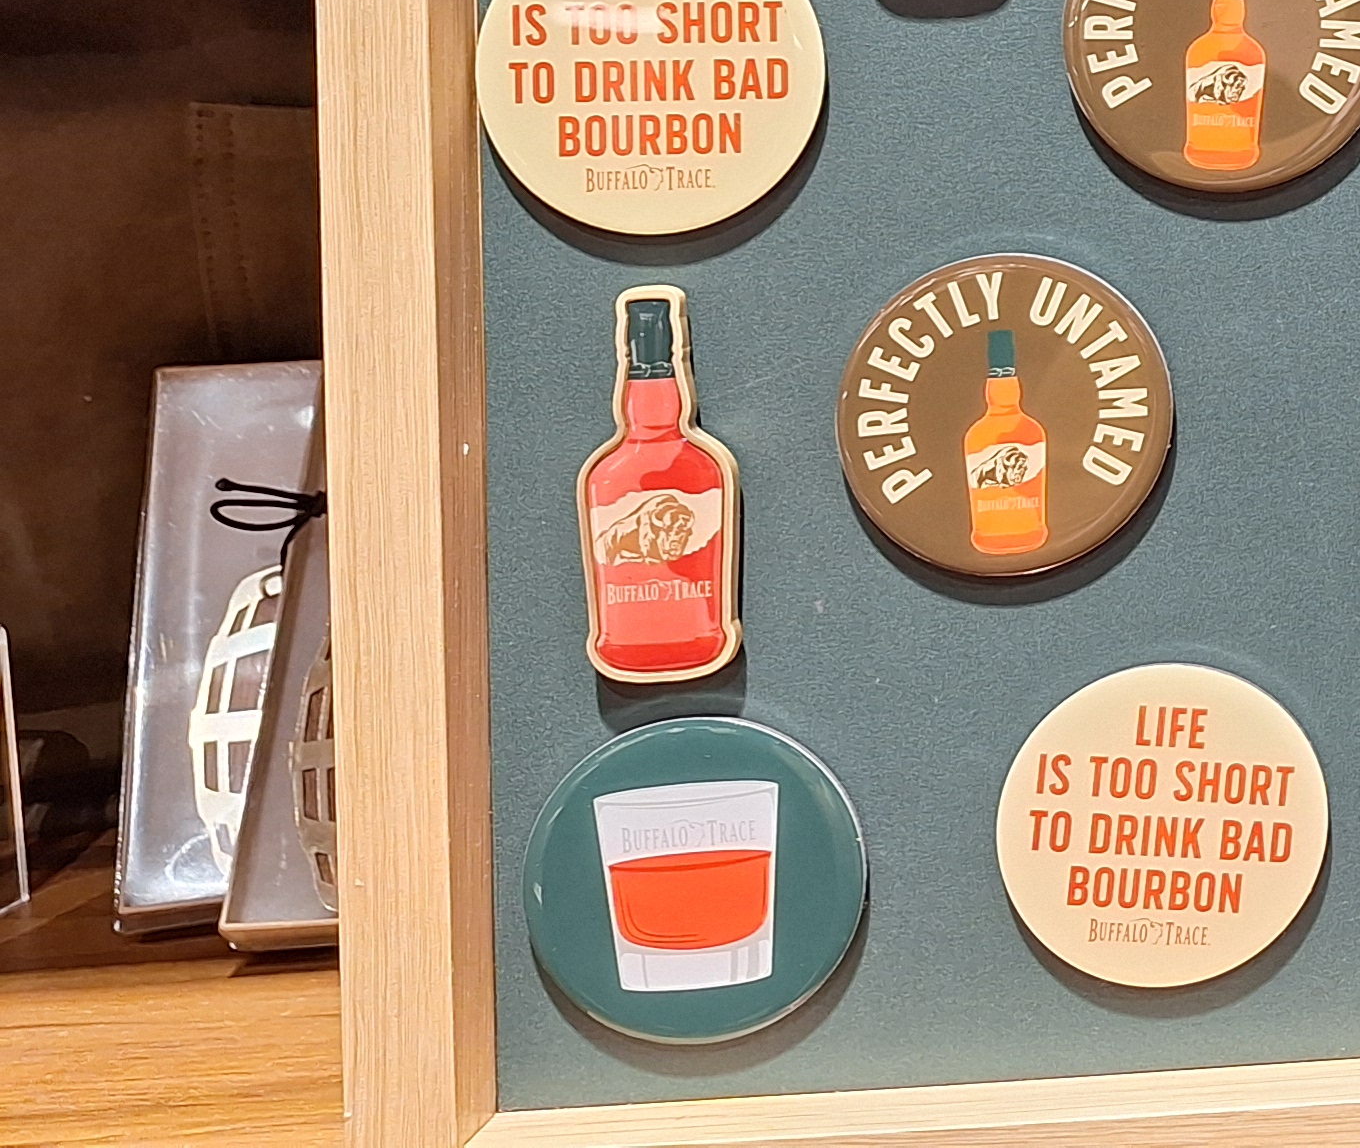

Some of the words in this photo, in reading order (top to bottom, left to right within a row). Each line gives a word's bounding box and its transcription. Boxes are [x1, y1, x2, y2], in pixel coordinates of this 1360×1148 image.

[512, 4, 547, 46] IS
[565, 3, 638, 45] TOO
[658, 1, 784, 43] SHORT
[509, 62, 554, 104] TO
[575, 60, 695, 102] DRINK
[713, 58, 788, 100] BAD
[558, 113, 742, 157] BOURBON
[585, 167, 647, 193] BUFFALO
[858, 271, 1003, 504] PERFECTLY
[1029, 276, 1148, 486] UNTAMED
[607, 583, 658, 604] BUFFALO
[672, 579, 712, 600] TRACE
[1136, 705, 1208, 749] LIFE
[1036, 754, 1071, 795] IS
[1090, 756, 1157, 799] TOO
[1174, 761, 1295, 806] SHORT
[622, 827, 688, 853] BUFFALO
[708, 820, 756, 845] TRACE
[1029, 810, 1072, 852] TO
[1089, 813, 1205, 858] DRINK
[1219, 819, 1293, 863] BAD
[1066, 865, 1243, 914] BOURBON
[1089, 918, 1147, 944] BUFFALO
